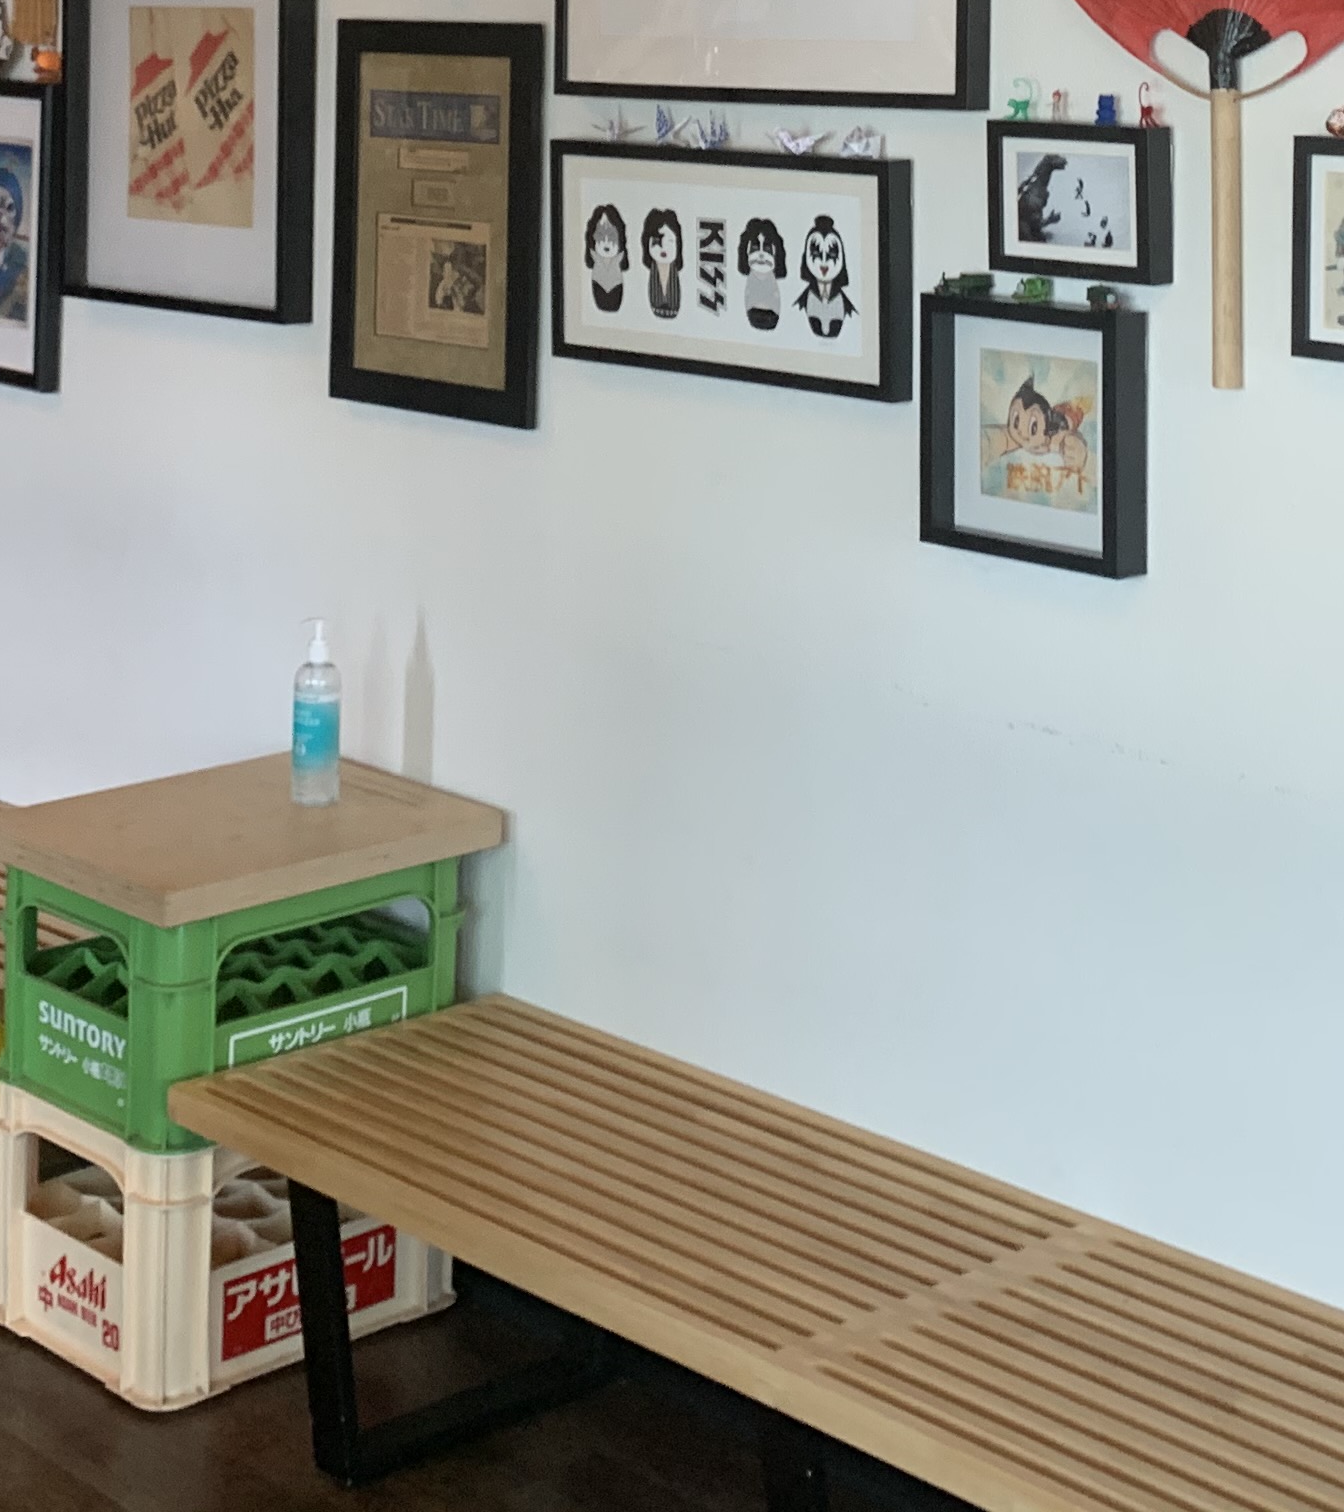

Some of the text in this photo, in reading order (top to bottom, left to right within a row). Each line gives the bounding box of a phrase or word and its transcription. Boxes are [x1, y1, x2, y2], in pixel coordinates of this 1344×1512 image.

[696, 216, 727, 317] KISS
[38, 999, 127, 1060] SUNTORY
[268, 1021, 336, 1054] サントリー
[49, 1252, 108, 1310] Asahi
